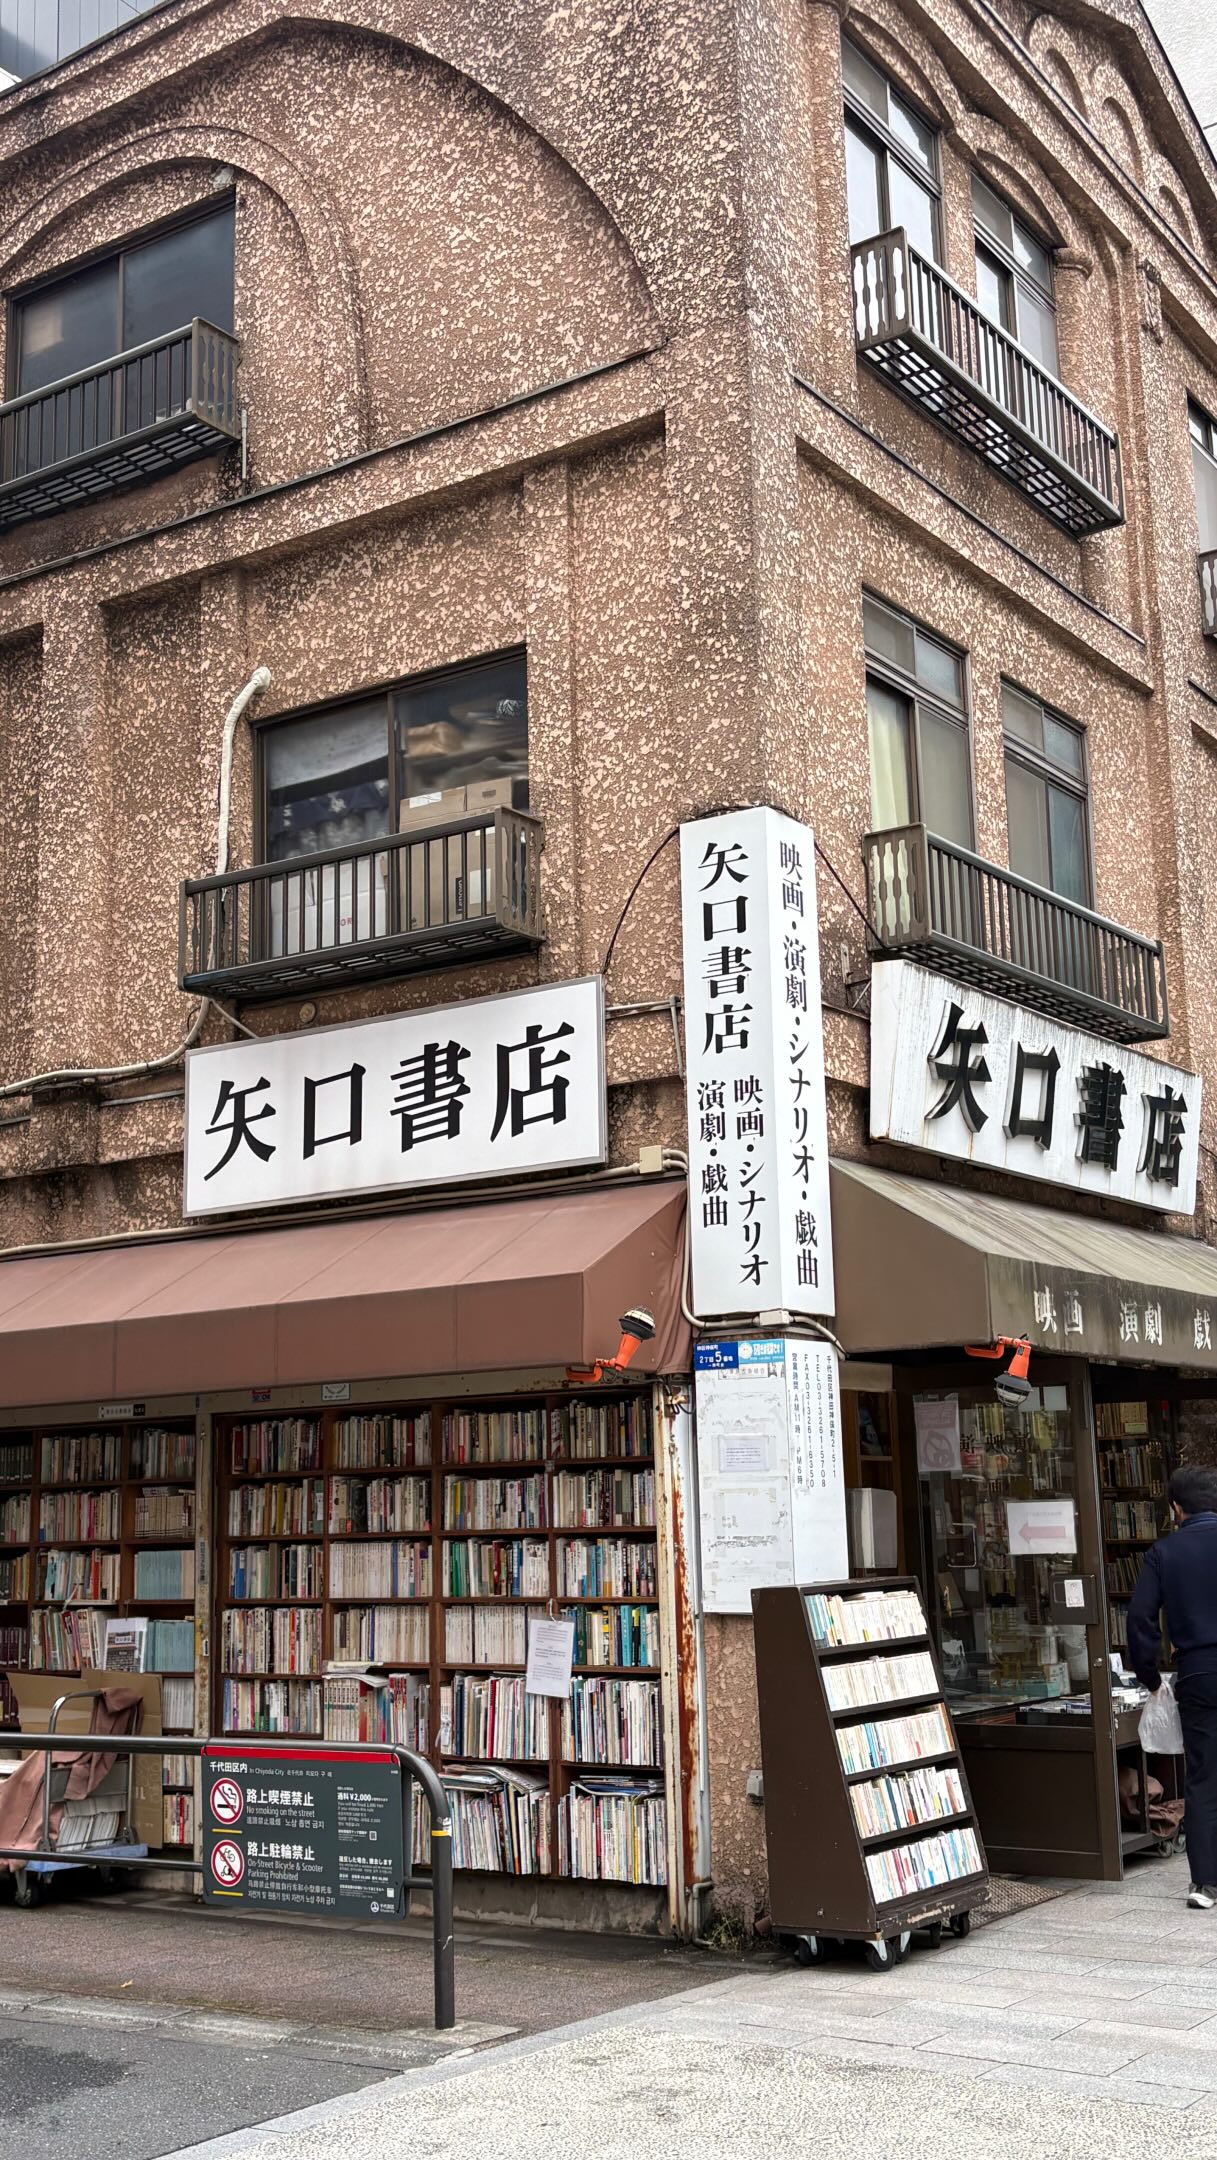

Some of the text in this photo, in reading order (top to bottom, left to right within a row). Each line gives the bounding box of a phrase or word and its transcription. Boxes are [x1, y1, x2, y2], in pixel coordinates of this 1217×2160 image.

[698, 842, 753, 1056] 矢口書店
[204, 1021, 575, 1182] 矢口書店
[779, 840, 819, 1289] 映画・演劇・シナリオ・戯曲
[924, 1000, 1189, 1188] 矢口書店
[697, 1079, 729, 1228] 演劇・戯曲
[734, 1074, 769, 1287] 映画・シナリオ
[209, 1761, 248, 1773] 千代田区内
[246, 1788, 314, 1807] 路上喫煙禁止
[246, 1806, 255, 1814] No
[255, 1807, 279, 1818] smoking
[287, 1807, 298, 1816] the
[298, 1808, 316, 1818] street
[247, 1841, 316, 1861] 路上駐輪禁止
[247, 1858, 274, 1869] On-Street
[274, 1861, 295, 1873] Bicycle
[301, 1862, 324, 1873] Scooter
[247, 1869, 299, 1881] Parking Prohibited
